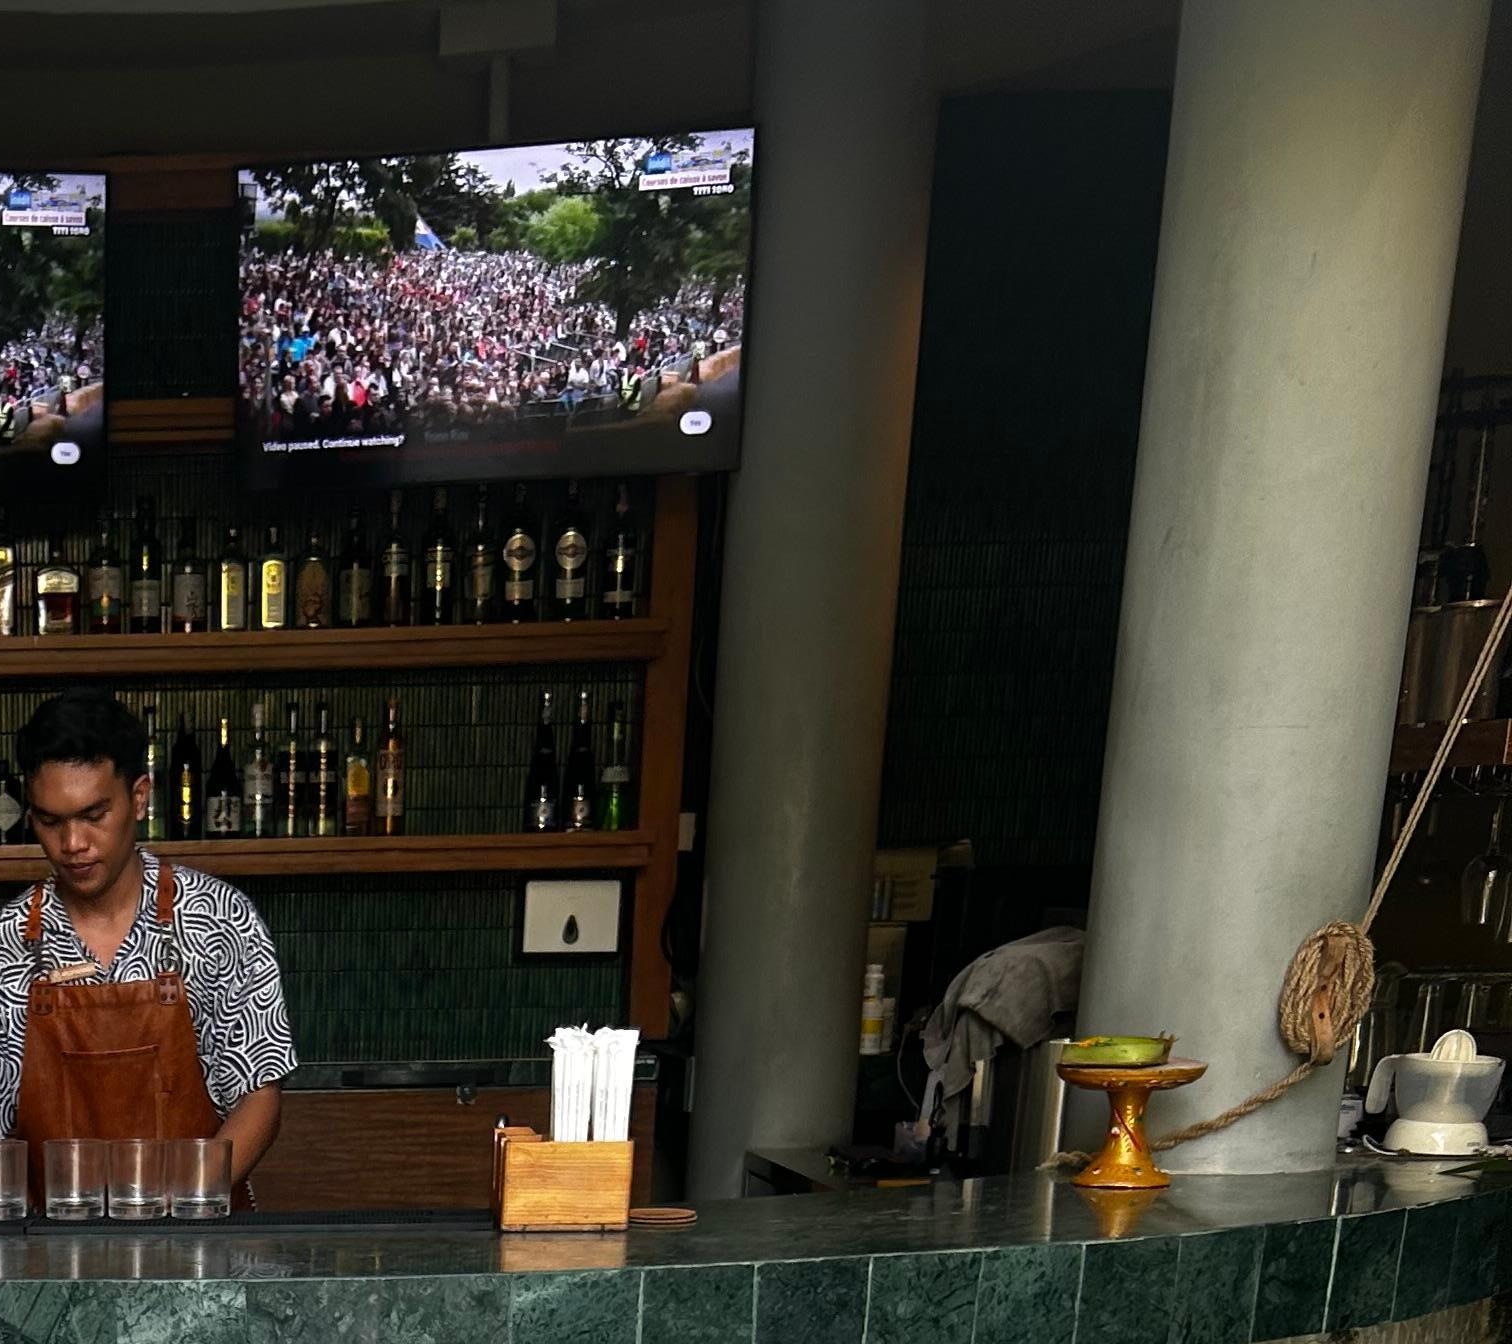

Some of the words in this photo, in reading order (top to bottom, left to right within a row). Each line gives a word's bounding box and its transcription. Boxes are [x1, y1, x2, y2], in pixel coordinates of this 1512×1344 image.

[262, 441, 287, 452] Video
[322, 438, 360, 449] Continue
[361, 434, 405, 447] watching?
